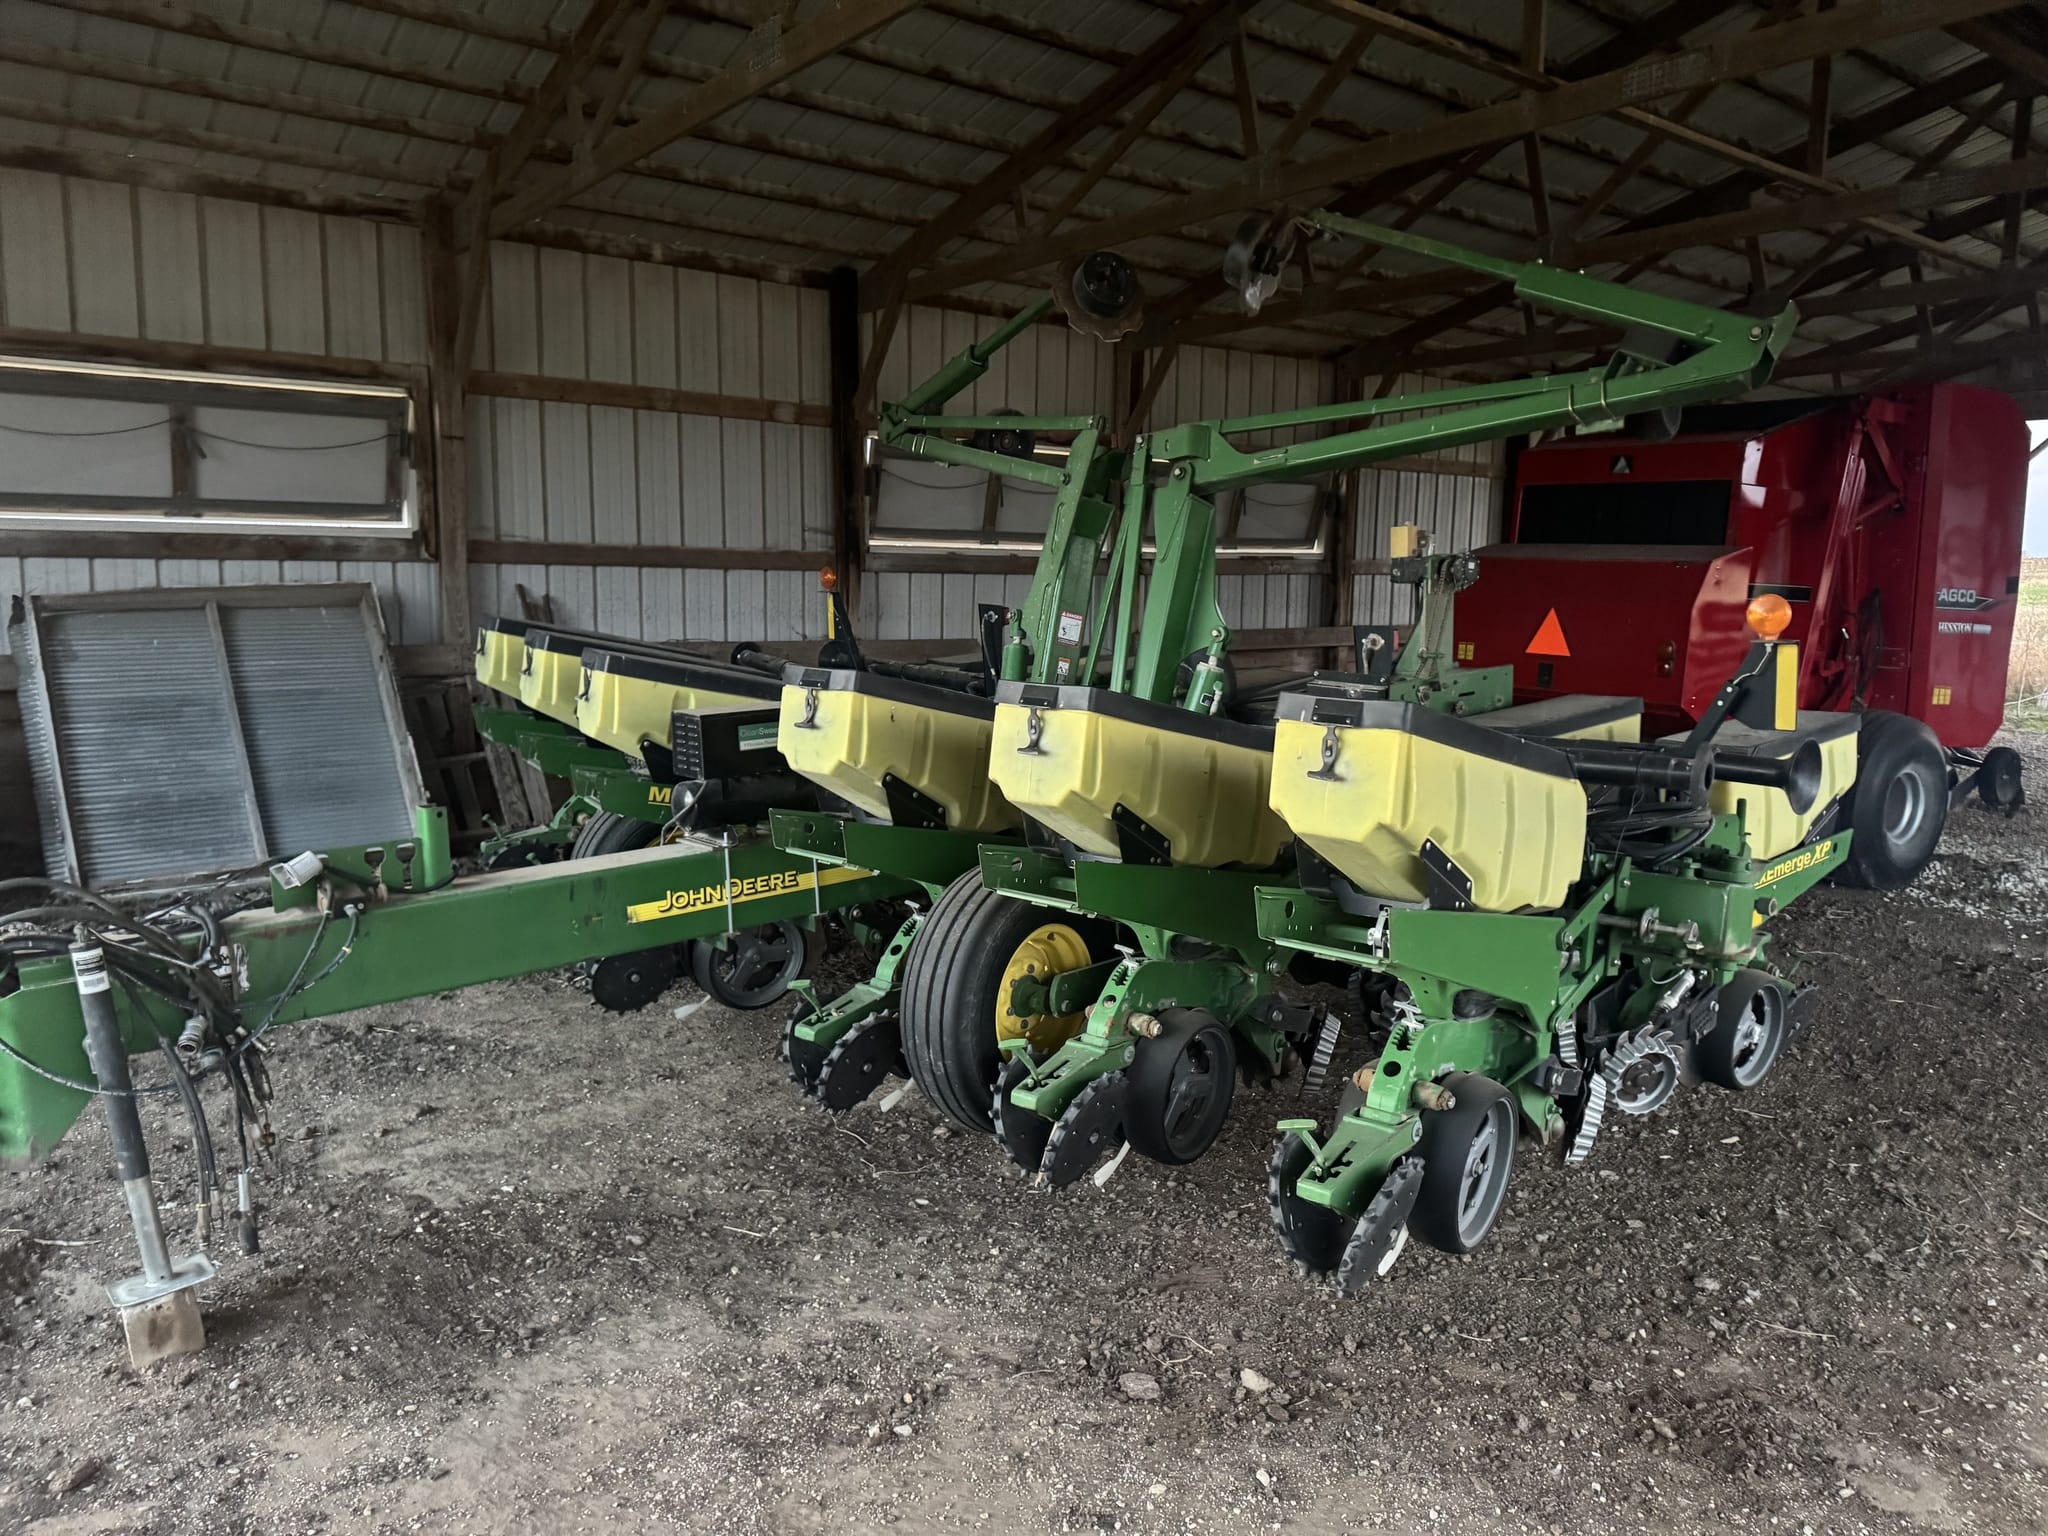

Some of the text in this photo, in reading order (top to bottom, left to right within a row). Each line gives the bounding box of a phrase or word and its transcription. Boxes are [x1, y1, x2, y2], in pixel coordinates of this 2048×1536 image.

[1938, 588, 1976, 603] AGCO
[1810, 840, 1832, 866] XP
[657, 870, 799, 913] JOHN DEERE
